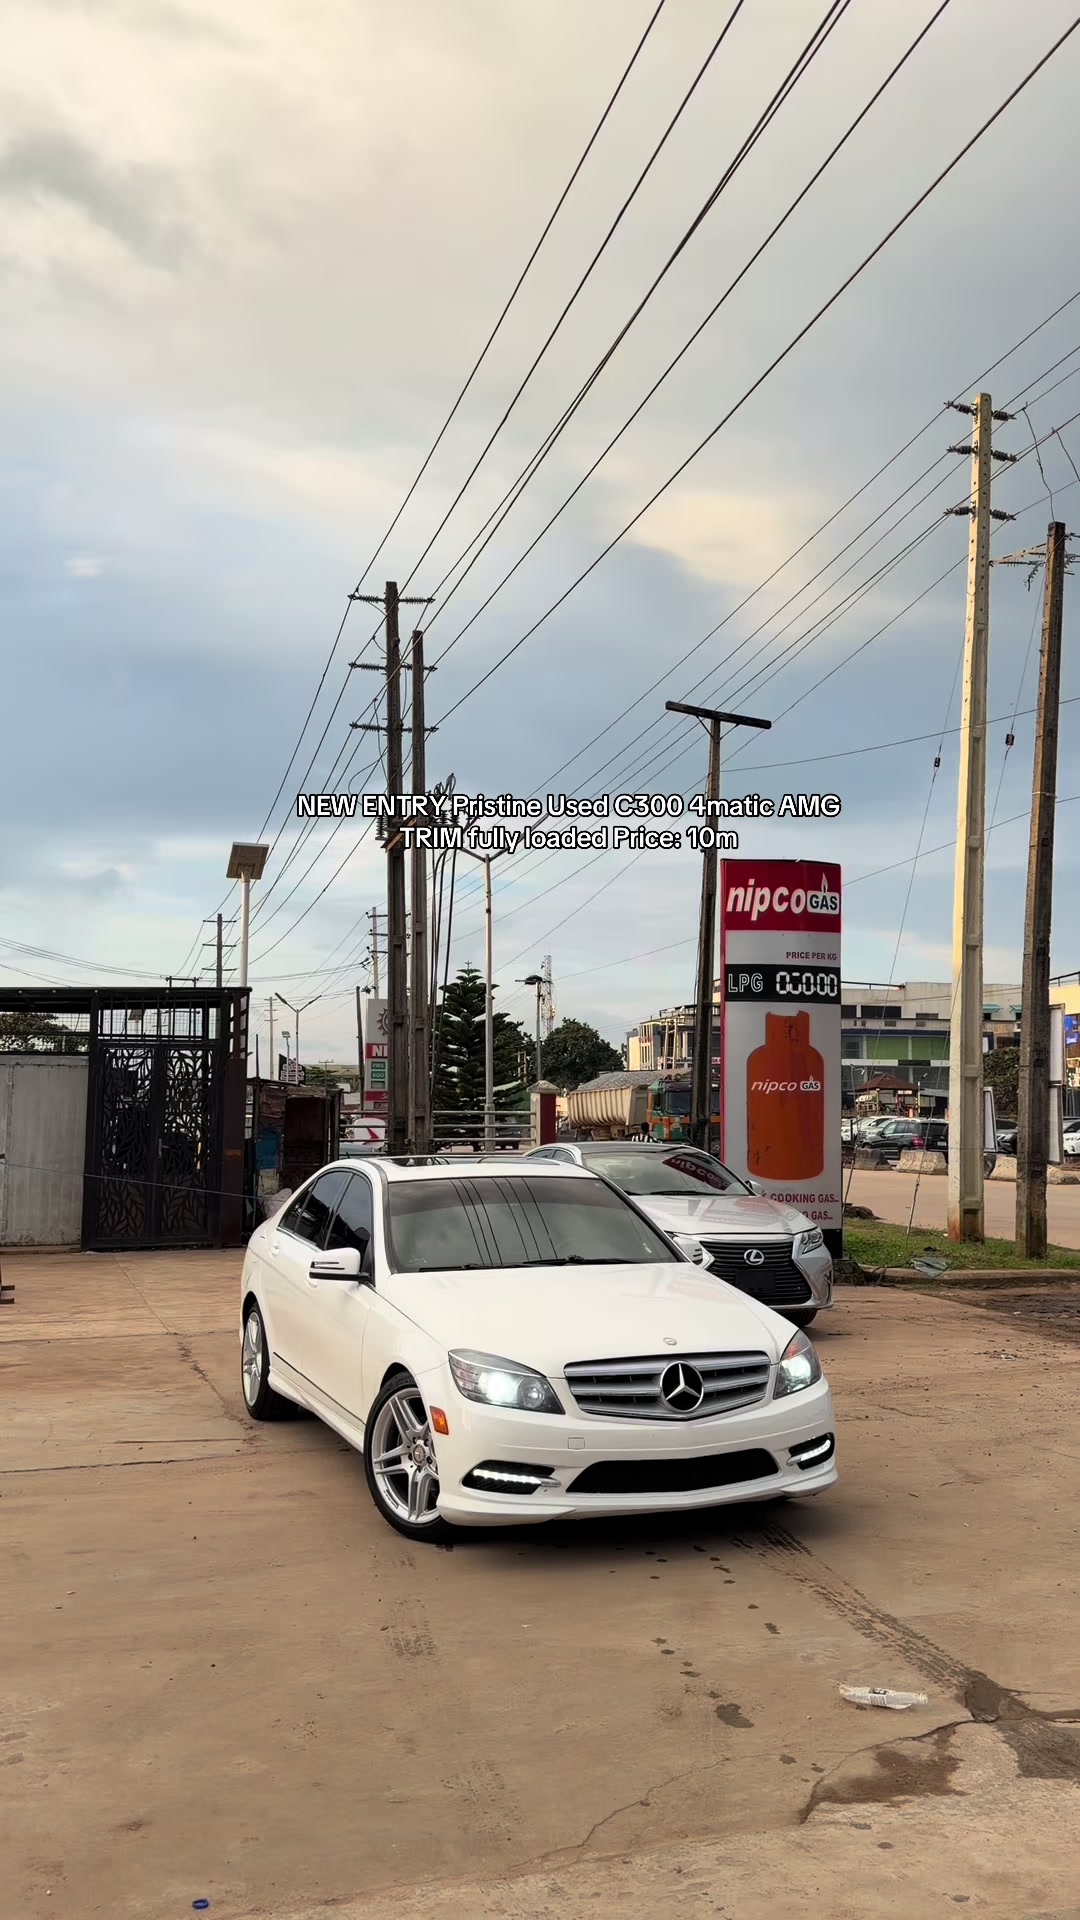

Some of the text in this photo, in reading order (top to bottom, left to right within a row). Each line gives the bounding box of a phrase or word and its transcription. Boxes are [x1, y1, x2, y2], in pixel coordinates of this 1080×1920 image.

[726, 878, 838, 921] nipco GAS
[785, 951, 837, 961] PRICE PER KG
[728, 973, 763, 993] LPG
[372, 1044, 388, 1057] NI
[751, 1079, 819, 1094] nipco GAS
[770, 1193, 816, 1203] COOKING
